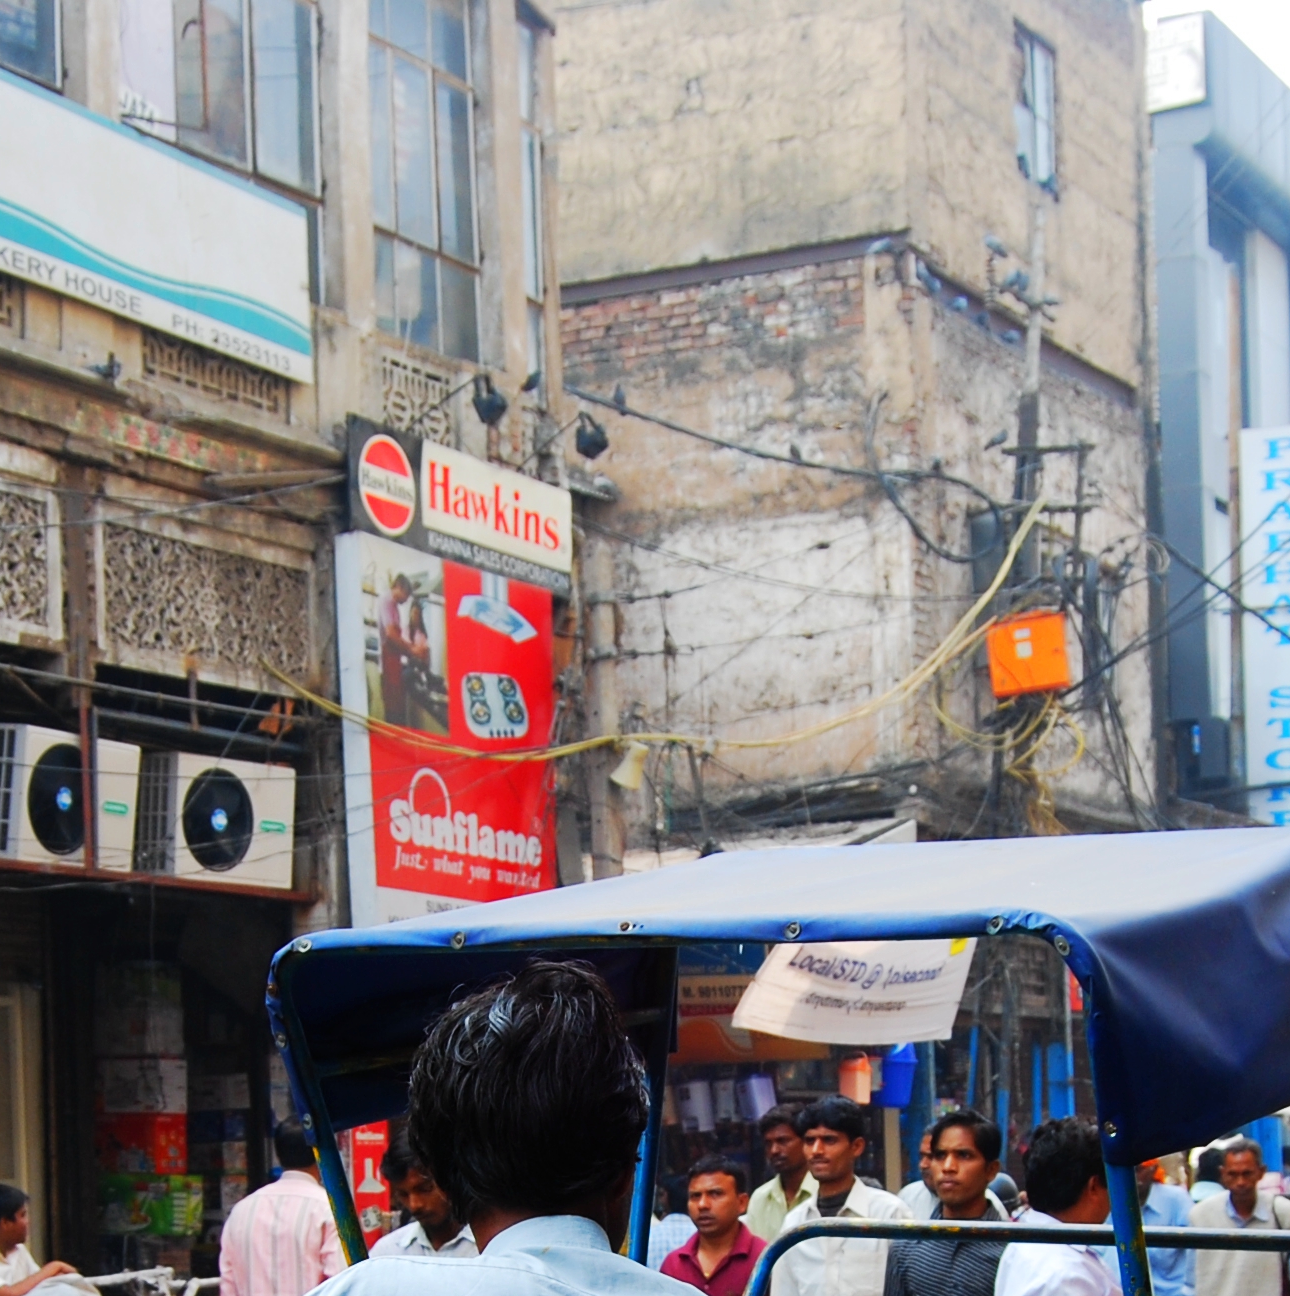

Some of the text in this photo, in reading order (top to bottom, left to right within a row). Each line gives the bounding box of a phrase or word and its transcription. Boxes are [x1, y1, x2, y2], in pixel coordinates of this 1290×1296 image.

[64, 271, 143, 316] HOUSE
[171, 312, 205, 339] PH:
[210, 325, 291, 372] 23523113
[361, 466, 414, 503] Hawkins
[428, 459, 561, 551] Hawkins
[428, 531, 570, 590] KHANNA SALES CORPORATION
[388, 797, 543, 867] Sunflame
[394, 844, 542, 889] Just what you wanted
